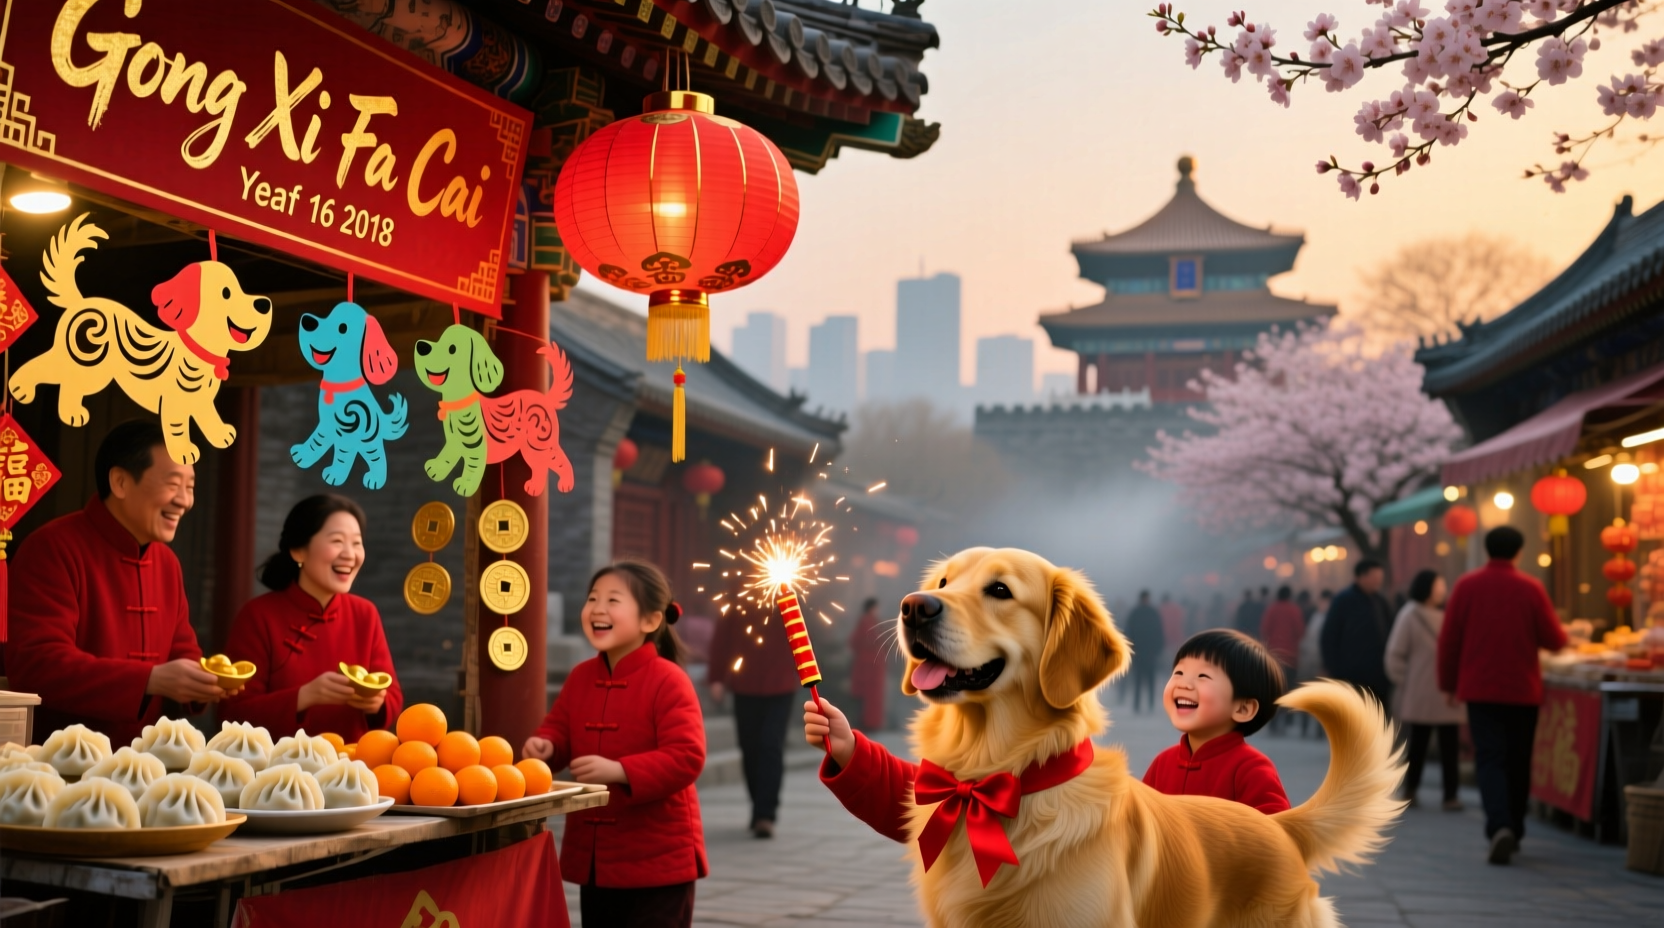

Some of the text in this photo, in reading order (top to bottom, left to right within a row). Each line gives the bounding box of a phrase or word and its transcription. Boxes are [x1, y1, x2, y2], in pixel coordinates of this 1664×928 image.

[51, 0, 491, 228] Gong Xi Fa Cai
[240, 165, 395, 247] Yeaf 16 2018
